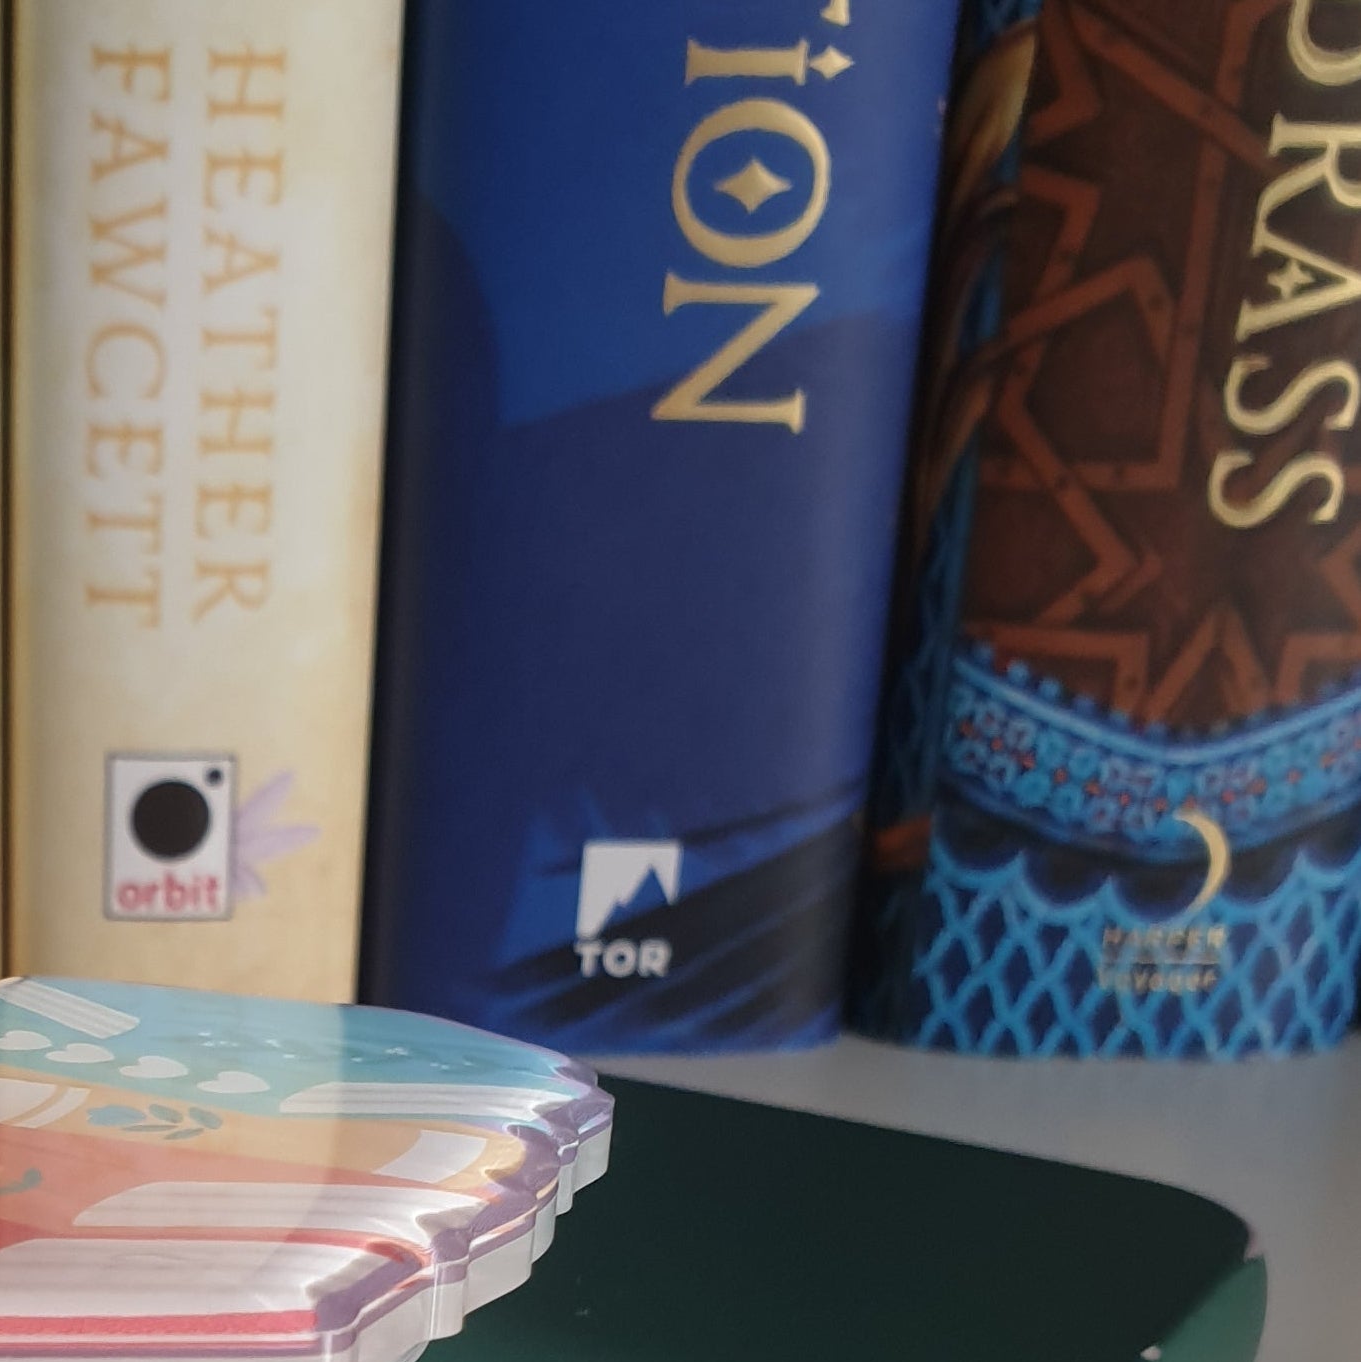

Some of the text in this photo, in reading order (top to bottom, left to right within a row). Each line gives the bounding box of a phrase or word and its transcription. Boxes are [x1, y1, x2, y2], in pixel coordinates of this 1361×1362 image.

[83, 44, 172, 630] FAWCETT
[190, 46, 287, 624] HEATHER
[650, 0, 855, 435] ION
[115, 872, 220, 912] orbit
[575, 939, 672, 977] TOR
